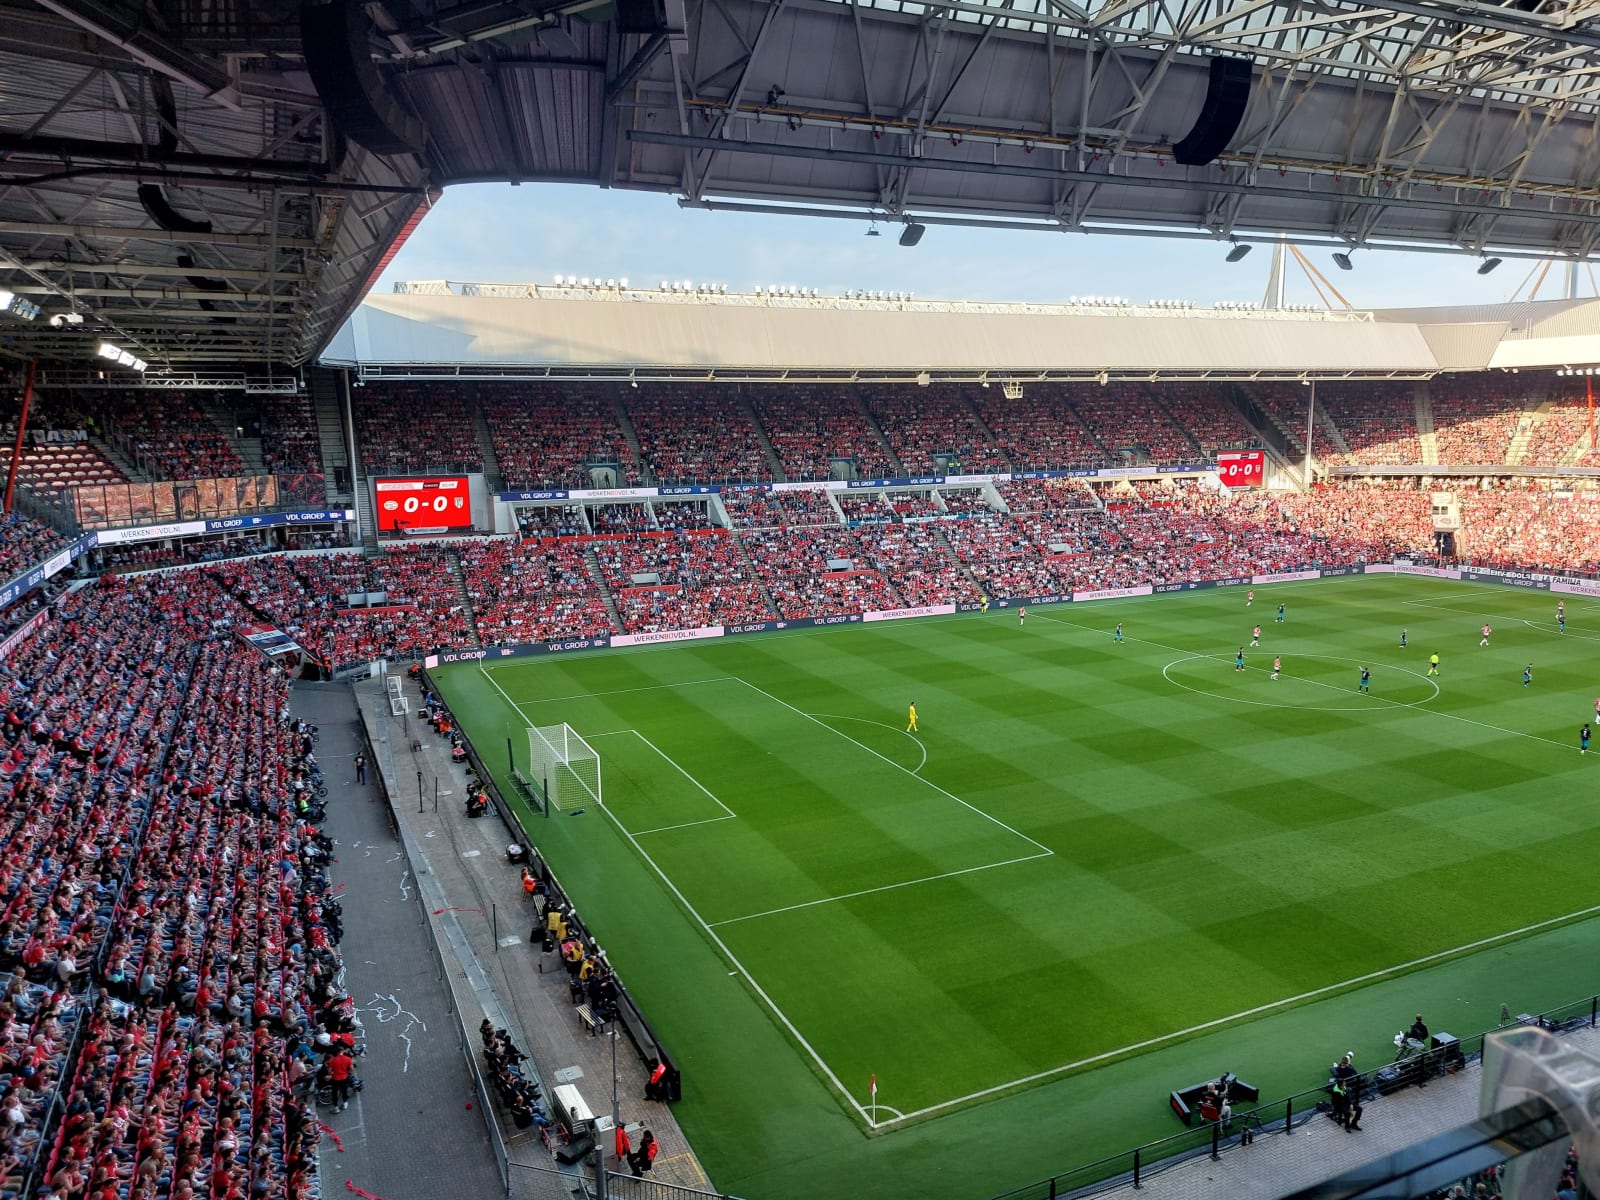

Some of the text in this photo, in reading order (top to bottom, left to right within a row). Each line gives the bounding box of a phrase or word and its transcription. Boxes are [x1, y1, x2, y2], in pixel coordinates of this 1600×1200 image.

[301, 512, 326, 520] GROEP
[211, 521, 223, 529] VDL
[223, 519, 243, 528] GROEP
[120, 526, 182, 539] WERKENBIJVDL.NL
[1514, 579, 1534, 587] GROEP
[826, 616, 847, 624] GROEP
[730, 624, 766, 633] VDL GROEP
[633, 630, 698, 643] WERKENBIJVDL.NL
[548, 643, 564, 651] VDL
[564, 641, 590, 650] GROEP
[443, 653, 459, 662] VDL
